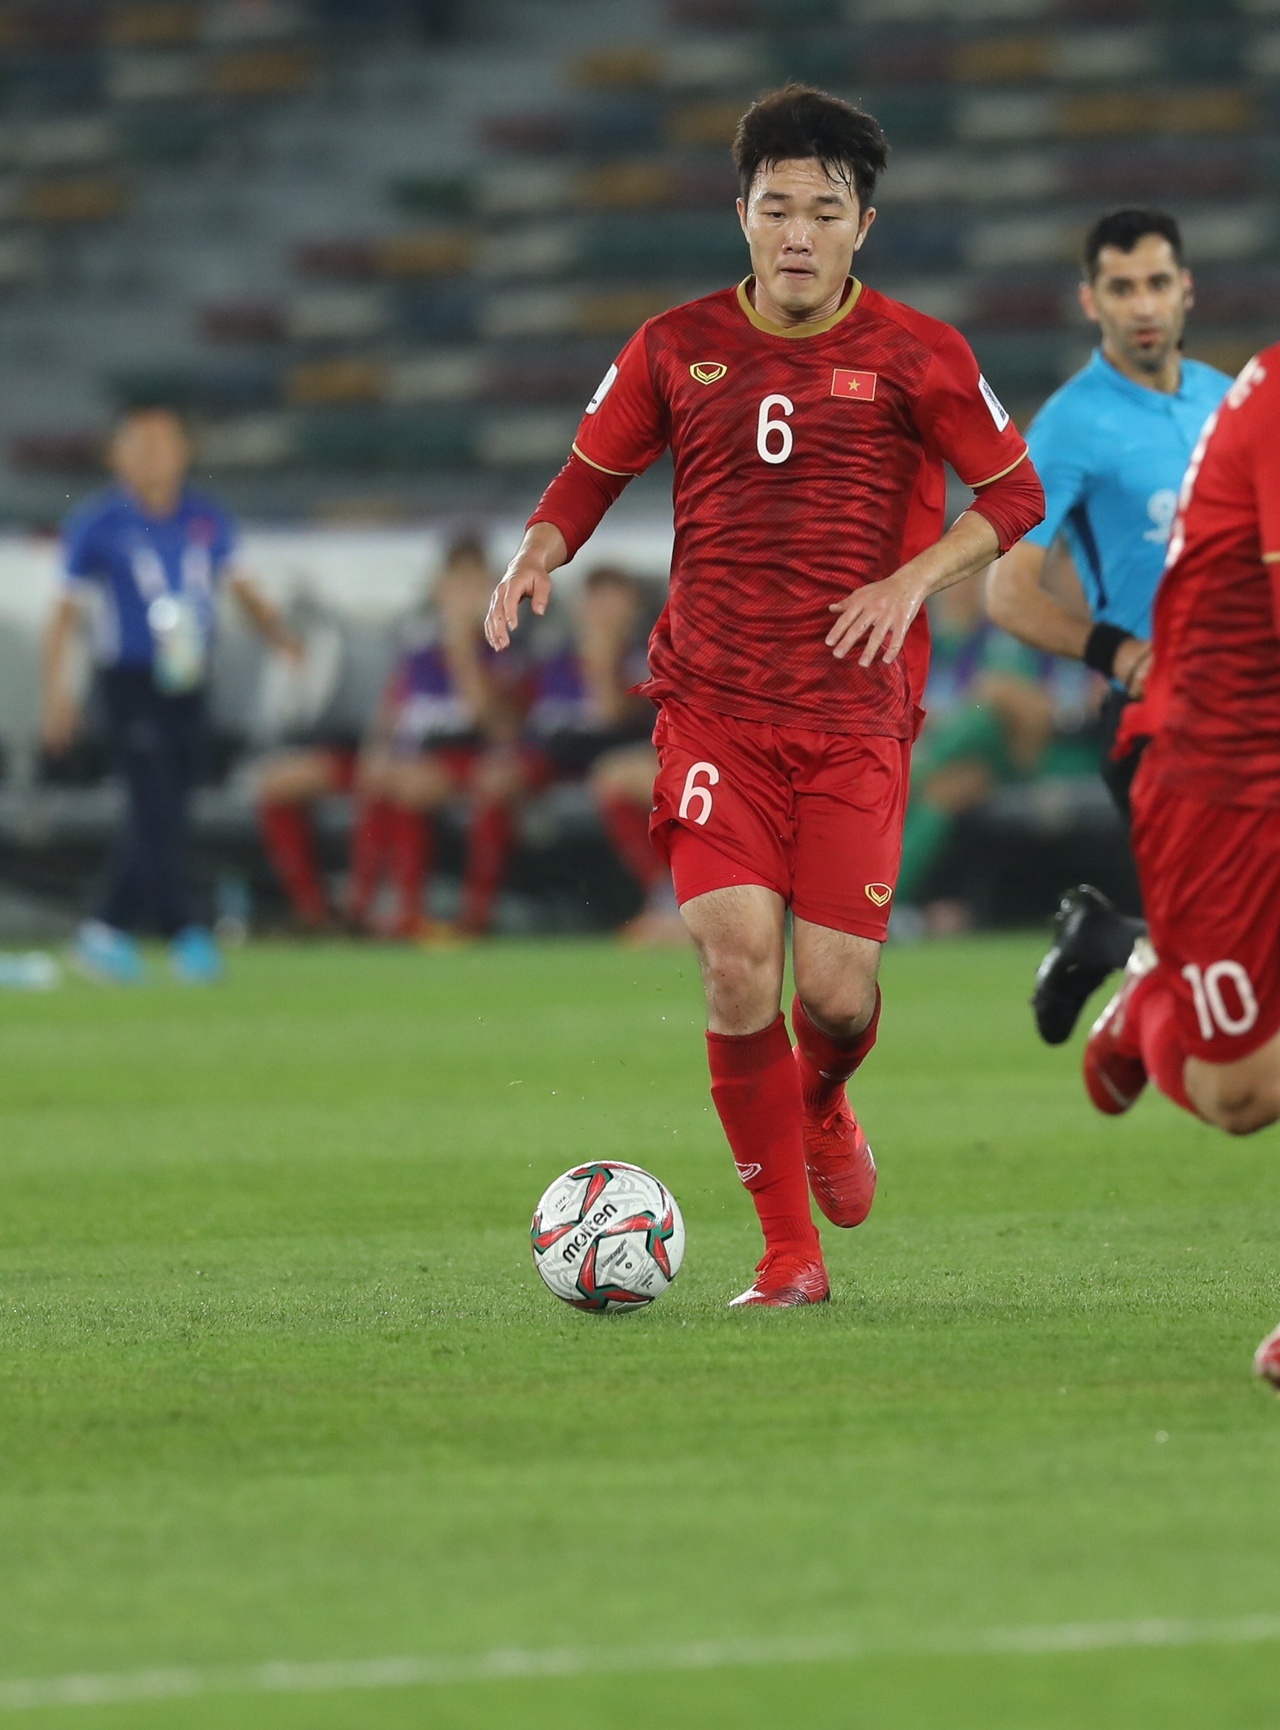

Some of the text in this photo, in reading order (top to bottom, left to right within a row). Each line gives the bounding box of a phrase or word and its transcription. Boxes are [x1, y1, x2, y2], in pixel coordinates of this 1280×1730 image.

[757, 394, 794, 464] 6
[678, 761, 719, 826] 6
[1181, 960, 1259, 1041] 10
[562, 1203, 618, 1264] molten
